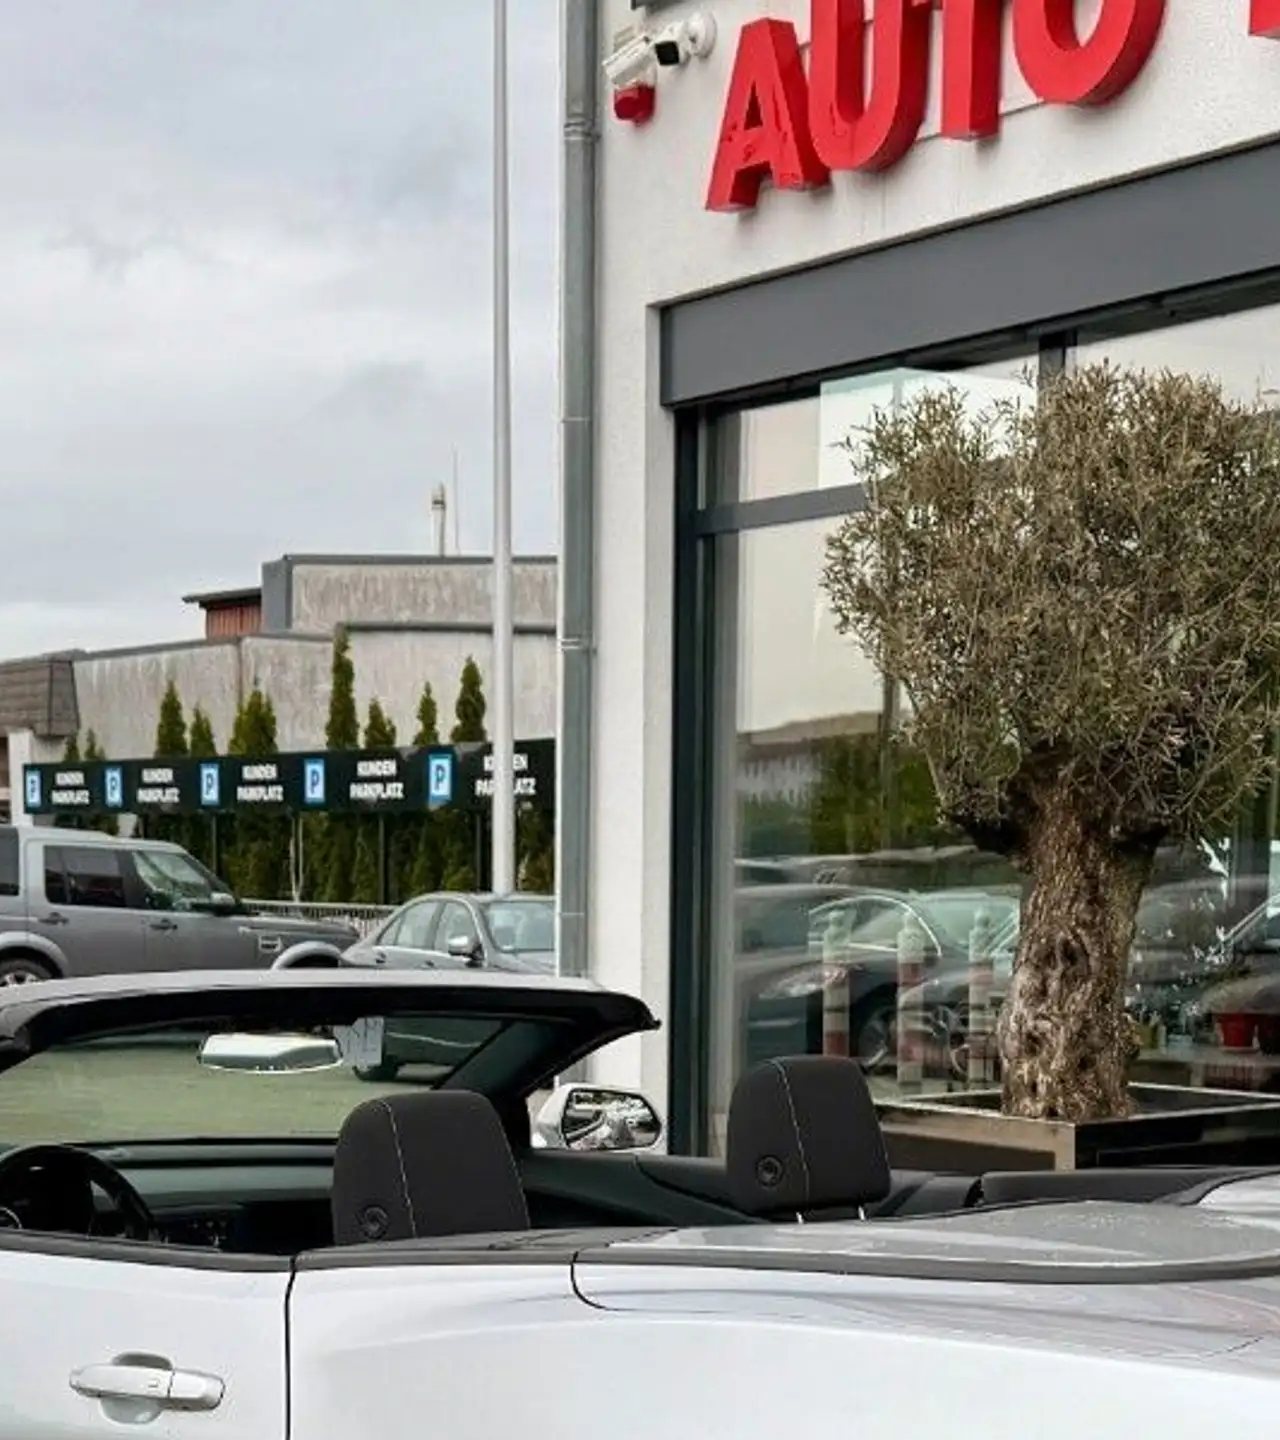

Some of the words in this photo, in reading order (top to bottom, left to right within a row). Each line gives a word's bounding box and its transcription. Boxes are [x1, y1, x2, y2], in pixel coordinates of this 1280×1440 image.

[706, 0, 1167, 212] AUTO
[243, 764, 277, 780] KUNDEN
[357, 759, 397, 776] KUNDEN
[237, 785, 284, 802] PARKPLATZ
[350, 782, 404, 799] PARKPLATZ
